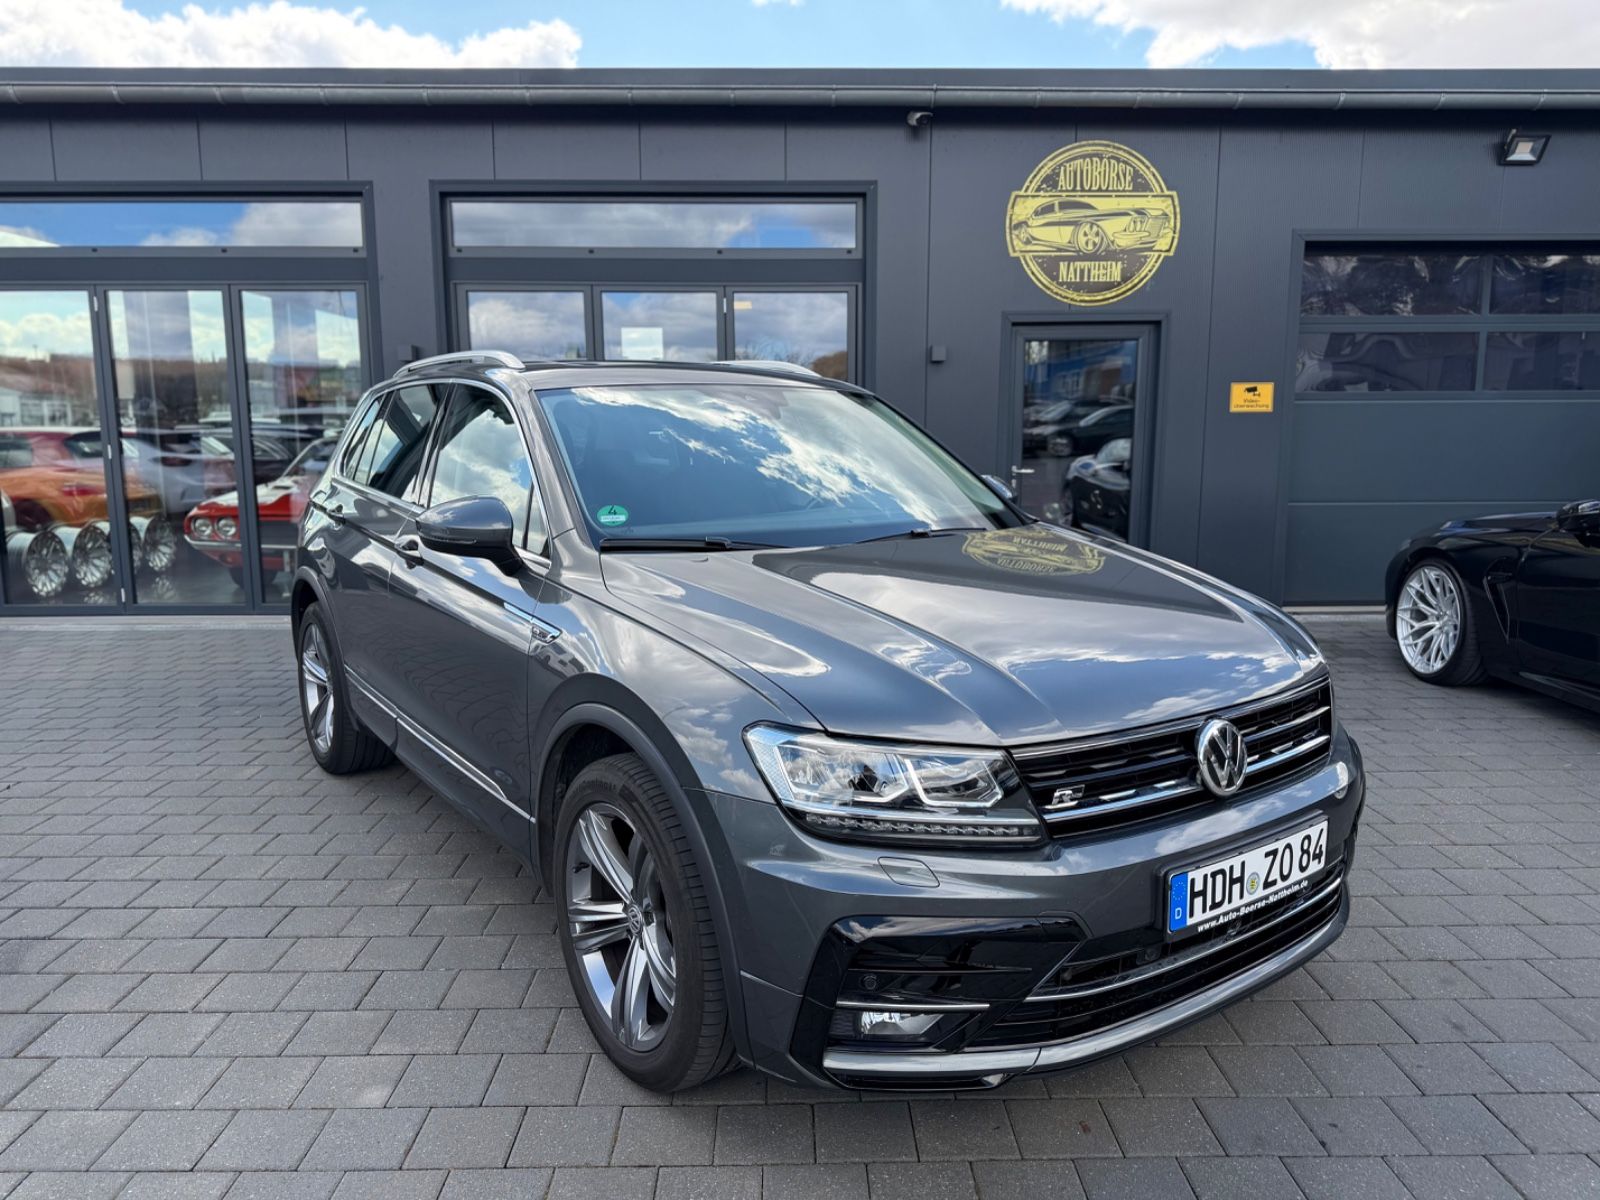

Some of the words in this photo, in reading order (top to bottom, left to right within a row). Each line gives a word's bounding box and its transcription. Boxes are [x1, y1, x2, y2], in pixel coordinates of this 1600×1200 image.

[1058, 261, 1122, 282] NATTHEIM
[608, 505, 617, 516] 4
[1188, 860, 1246, 919] HDH
[1262, 842, 1294, 891] ZO
[1298, 828, 1324, 874] 84
[1175, 907, 1182, 919] D
